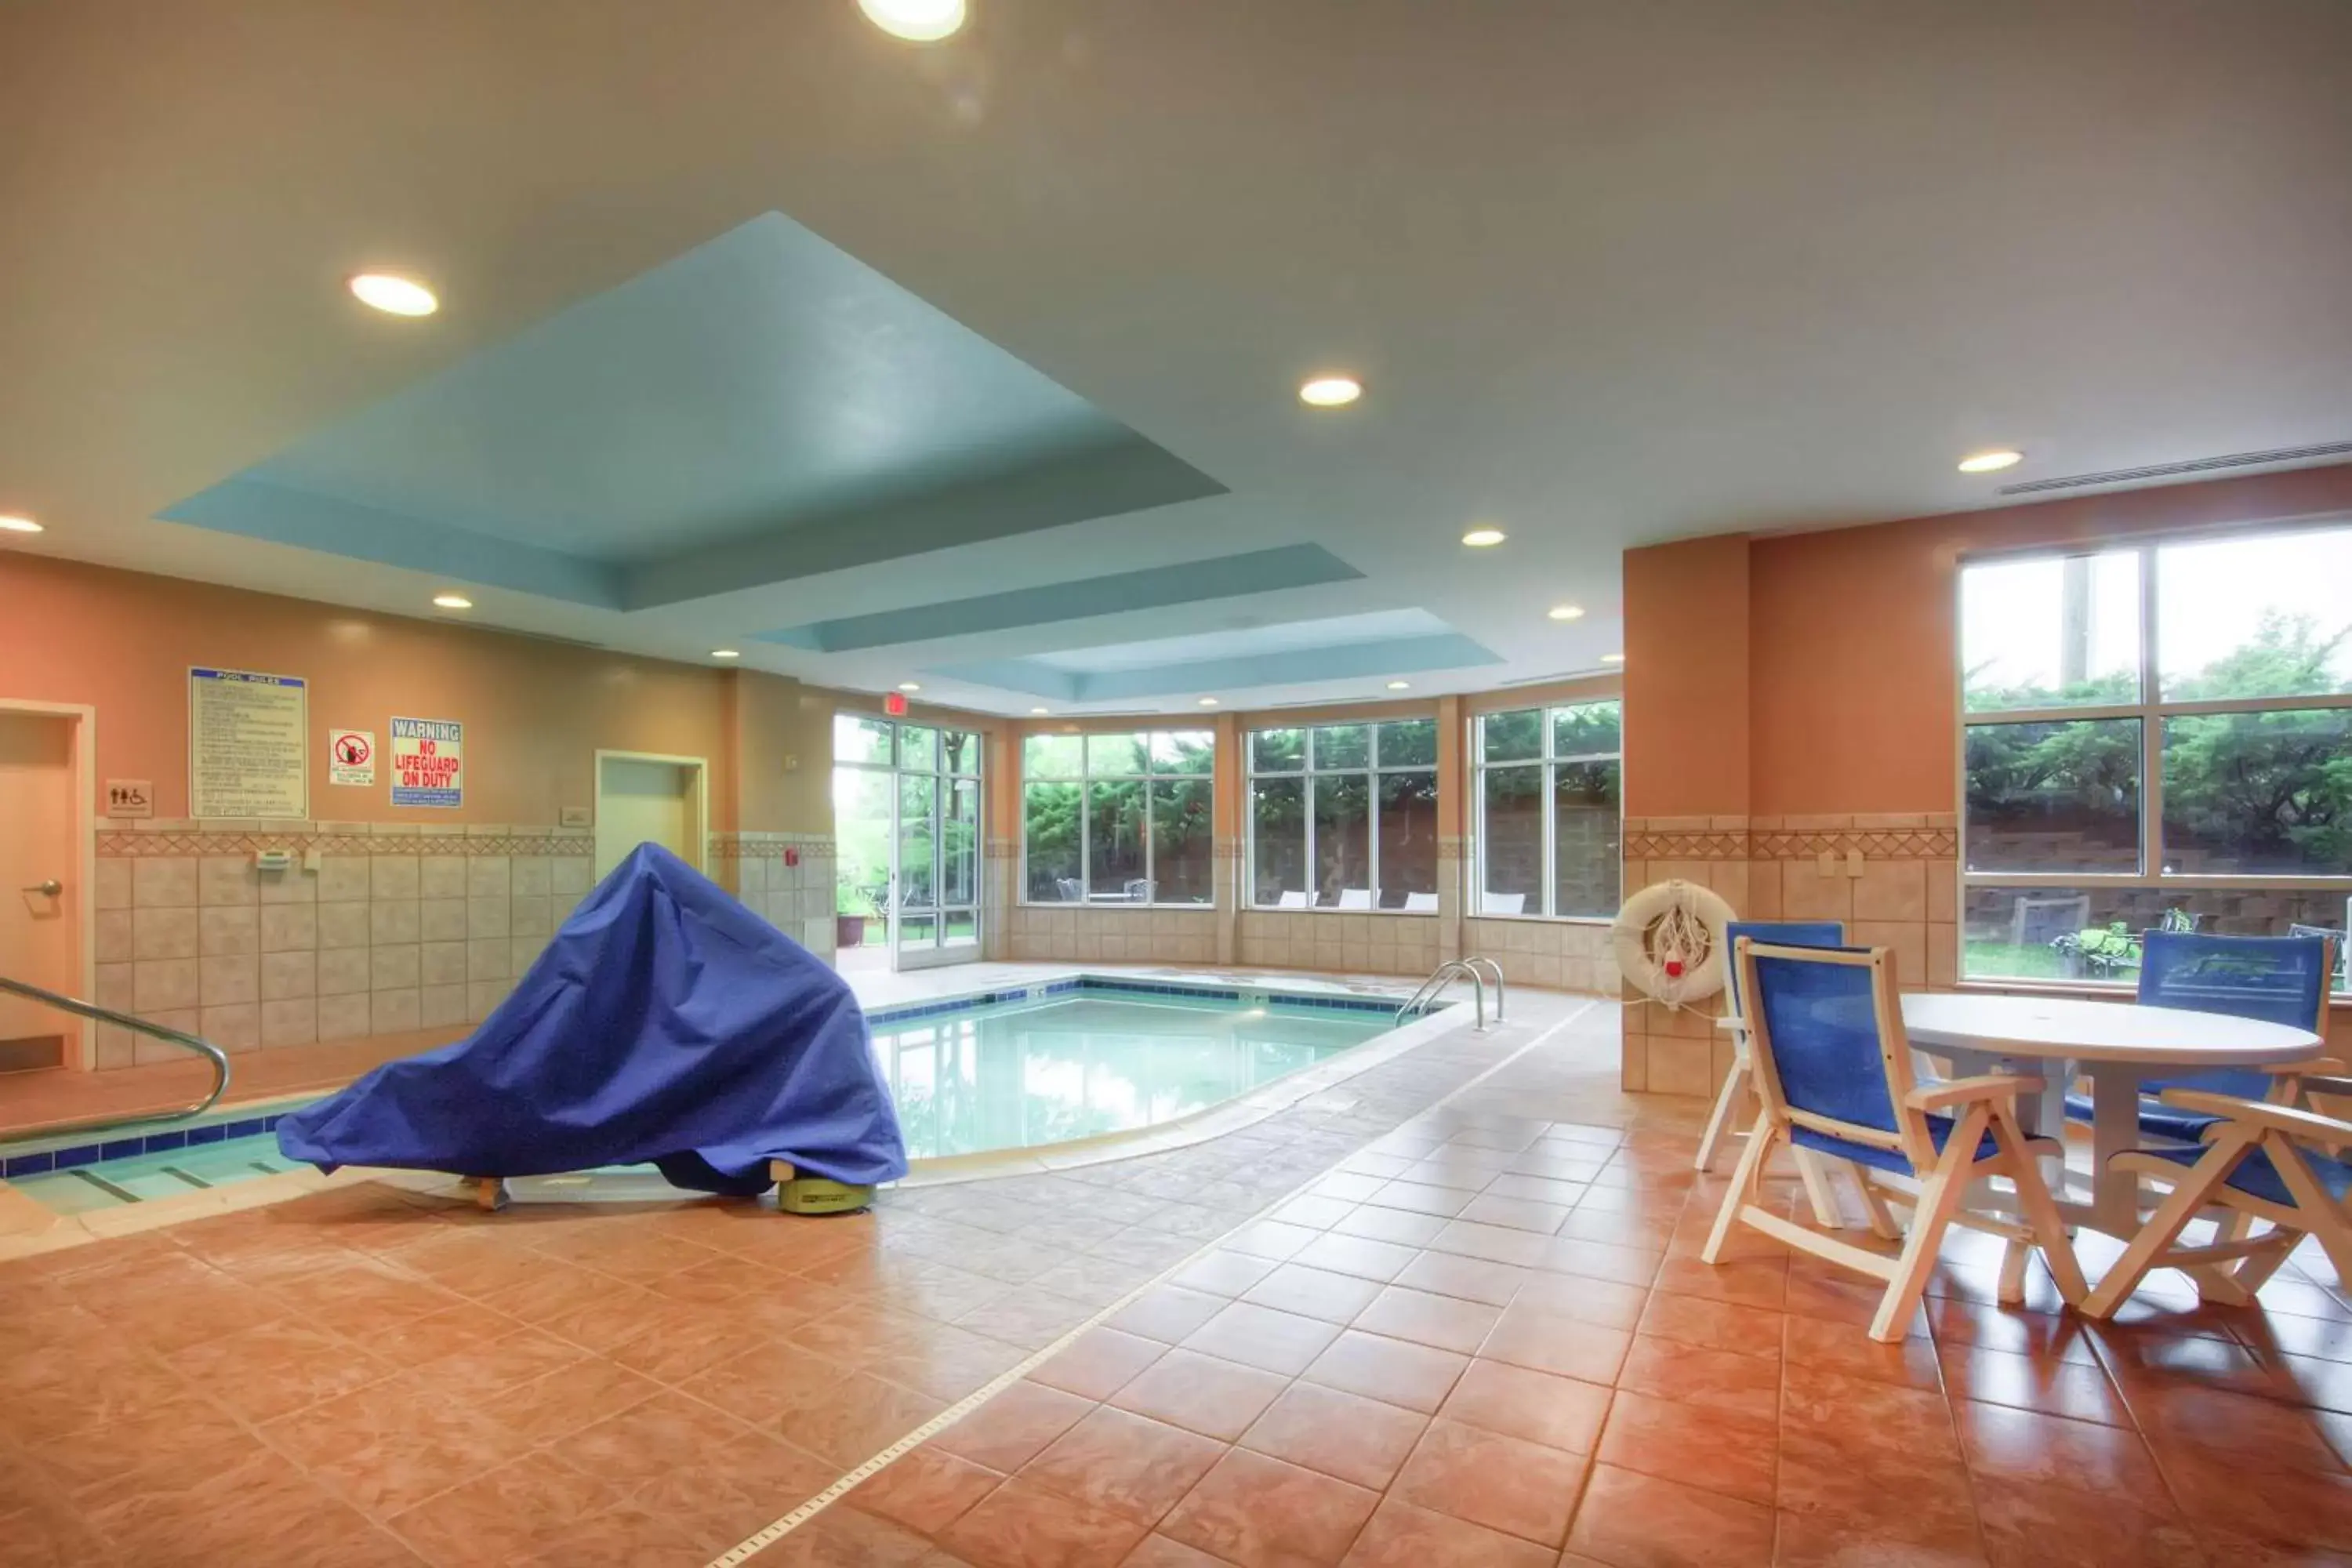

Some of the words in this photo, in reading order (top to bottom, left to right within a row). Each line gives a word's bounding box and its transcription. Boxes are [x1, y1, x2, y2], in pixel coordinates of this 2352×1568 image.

[394, 720, 459, 739] WARNING
[419, 740, 436, 755] NO
[395, 753, 459, 772] LIFEGUARD
[402, 771, 419, 786] ON
[423, 773, 452, 788] DUTY
